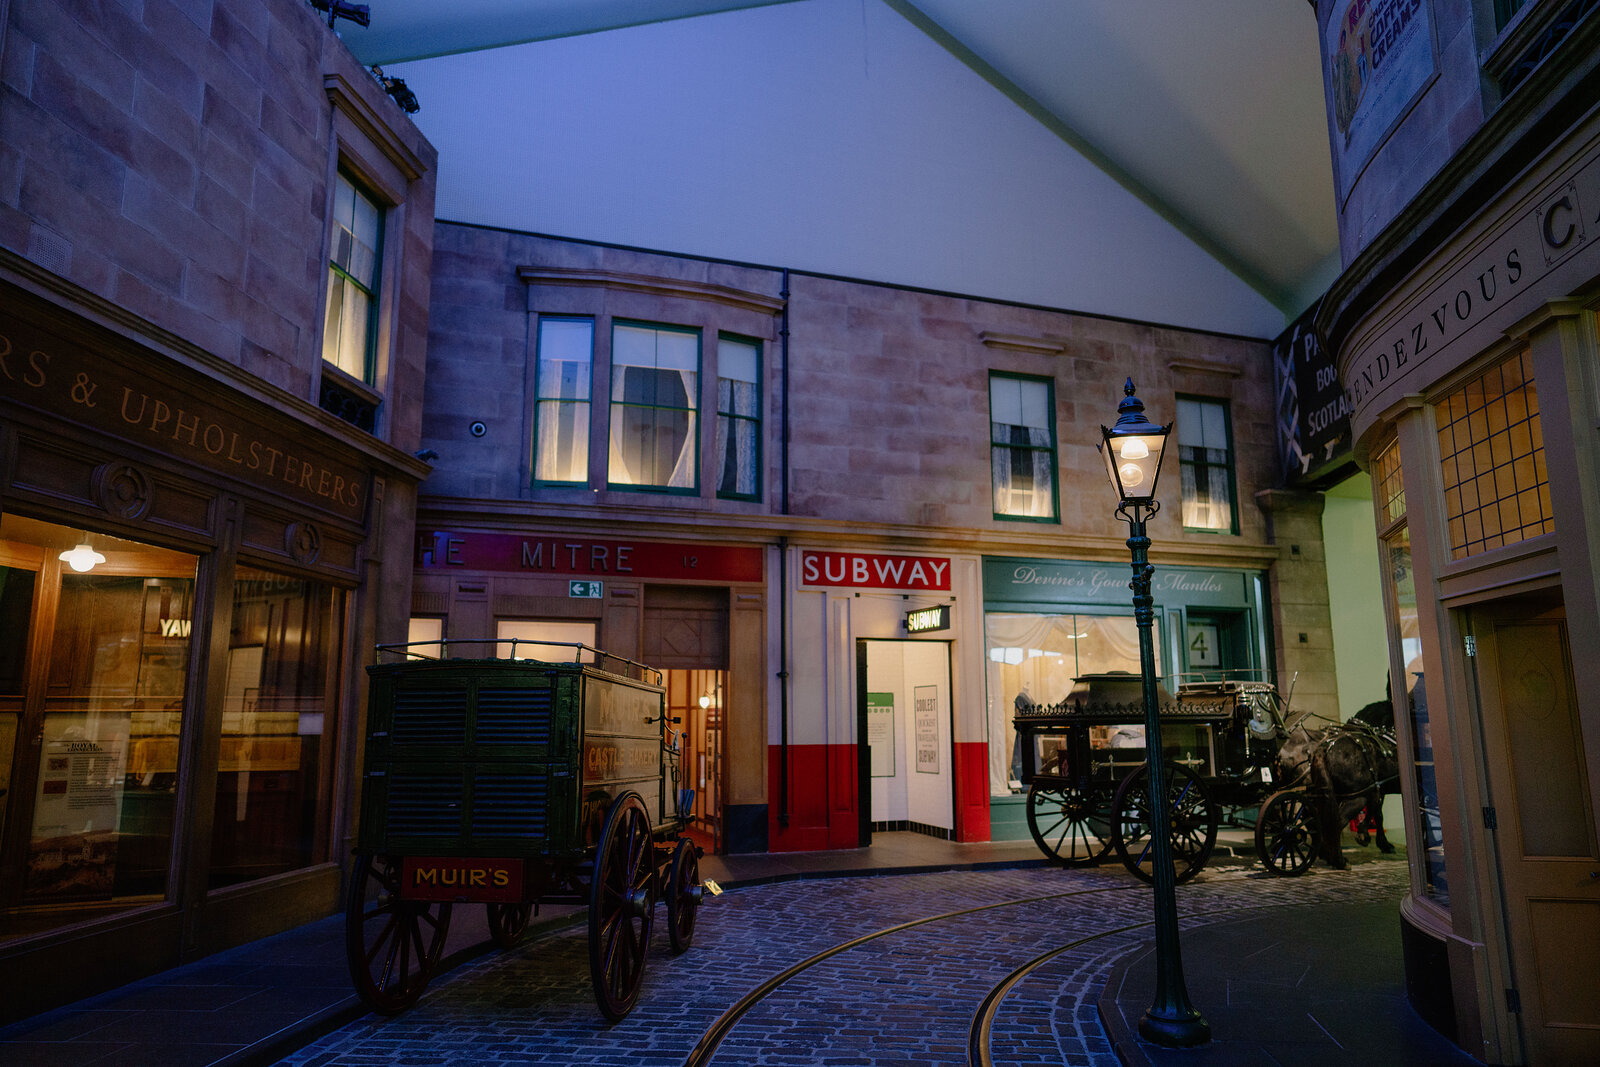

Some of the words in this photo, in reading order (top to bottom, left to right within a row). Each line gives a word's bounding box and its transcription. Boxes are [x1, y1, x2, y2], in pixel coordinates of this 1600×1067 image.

[71, 371, 98, 408] &
[119, 385, 361, 507] UPHOLSTERERS
[522, 541, 634, 572] MITRE
[804, 556, 948, 586] SUBWAY
[1012, 566, 1085, 586] Devine's
[1156, 573, 1223, 592] Mantles
[908, 608, 942, 631] SUBWAY
[1190, 631, 1208, 660] 4
[916, 698, 936, 712] COOLEST
[588, 746, 625, 771] CASTLE
[415, 867, 510, 889] MUIR'S
